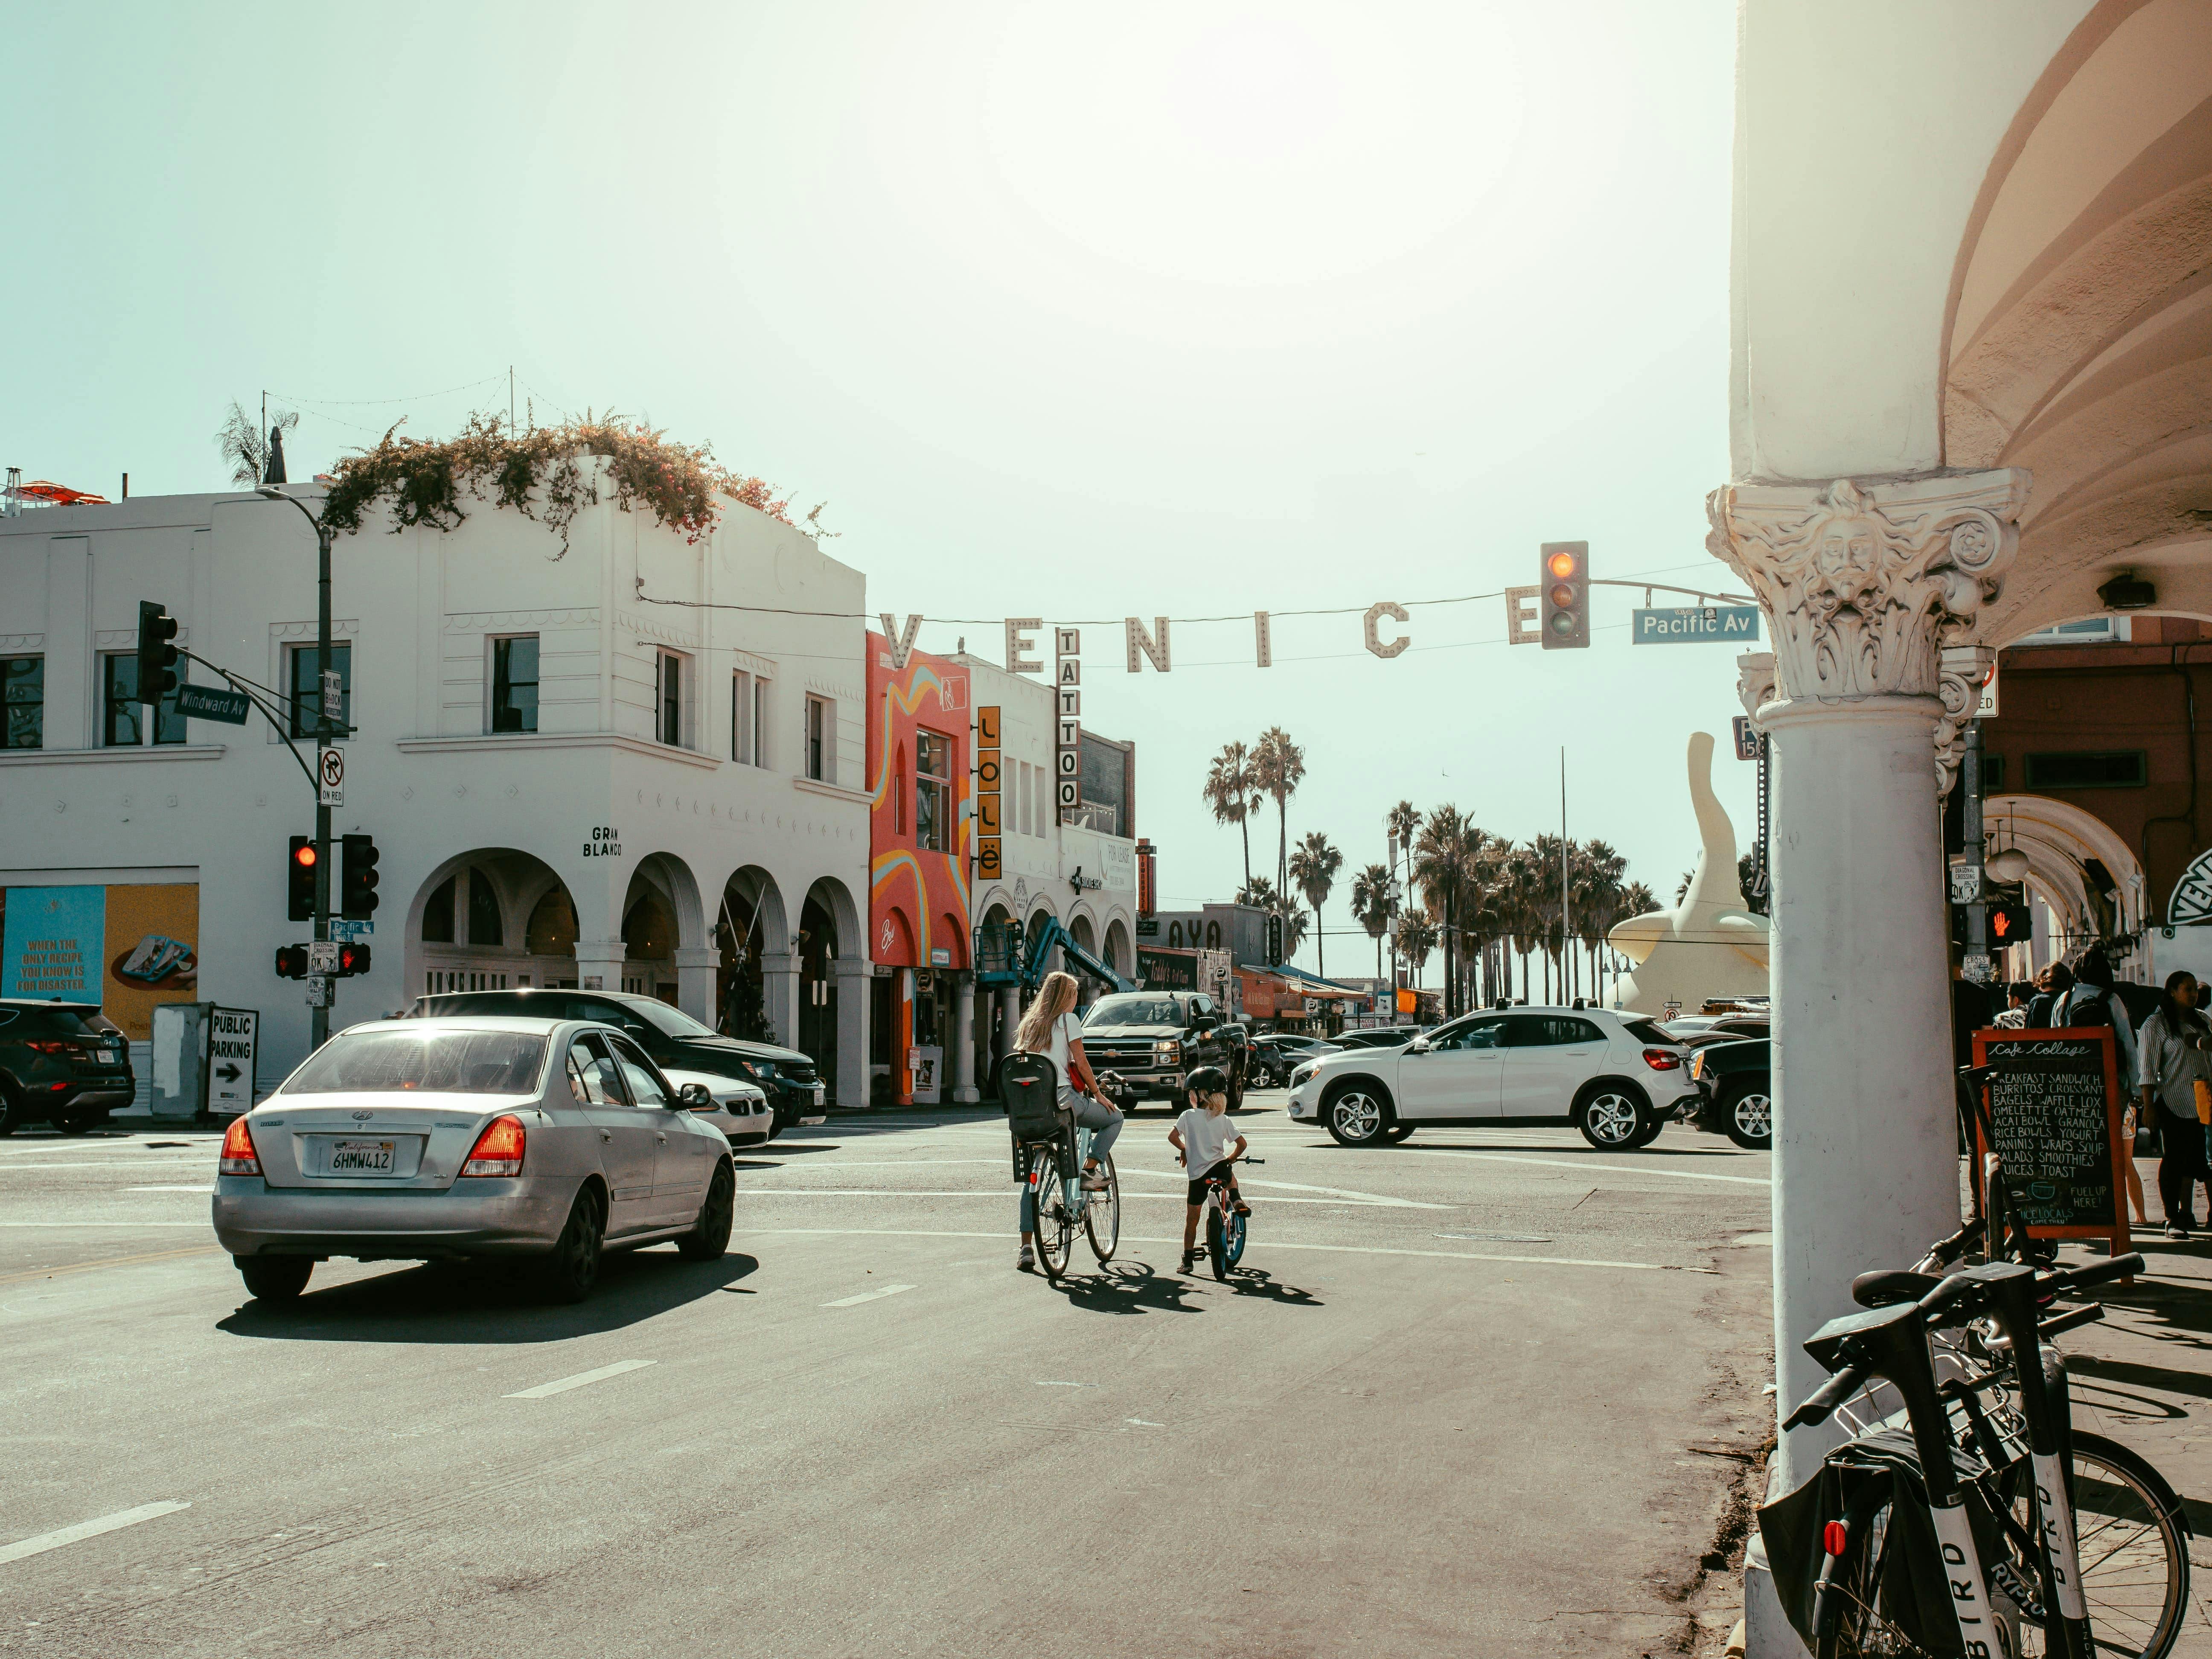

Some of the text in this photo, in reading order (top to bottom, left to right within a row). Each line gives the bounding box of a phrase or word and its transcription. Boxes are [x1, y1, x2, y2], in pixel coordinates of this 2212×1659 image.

[879, 585, 1542, 673] VENICE
[1644, 614, 1749, 634] Pacific Av
[326, 677, 331, 688] DO
[181, 692, 244, 716] Windward Av
[1979, 697, 1993, 709] ED
[1061, 632, 1075, 803] TATTOO
[1742, 742, 1755, 757] 15
[323, 791, 342, 801] ON RED
[592, 827, 618, 841] GRAN
[583, 843, 621, 857] BLANCO
[1109, 844, 1117, 862] FOR
[1117, 847, 1130, 864] LEASE
[1082, 877, 1094, 888] SMOKE
[2175, 857, 2212, 917] VEN
[1169, 920, 1221, 952] AYA
[27, 939, 77, 951] WHEN THE
[22, 952, 83, 965] ONLY RECIPE
[311, 957, 322, 969] OK
[21, 966, 84, 978] YOU KNOW IS
[17, 979, 86, 991] FOR DISASTER.
[213, 1015, 251, 1035] PUBLIC
[211, 1040, 251, 1059] PARKING
[1988, 1042, 2025, 1057] Cafe
[1998, 1073, 2100, 1086] EAKFAST SANDWICH
[1994, 1084, 2105, 1095] BURRITOS CROISSANT
[1994, 1094, 2101, 1108] BAGELS WAFFLE LOX
[1994, 1106, 2104, 1119] OMELETTE OATMEAL
[1994, 1116, 2105, 1130] ACAI BOWL GRANOLA
[1995, 1127, 2100, 1141] RICE BOWLS YOGURT
[344, 1142, 382, 1153] California
[1995, 1139, 2105, 1156] PANINIS WRAPS SOUP
[334, 1153, 389, 1168] 6HMW412
[2001, 1151, 2095, 1167] ALADS SMOOTHIES
[2040, 1165, 2076, 1178] TOAST
[2071, 1186, 2107, 1196] FUEL UP
[2074, 1198, 2101, 1208] HERE!
[2038, 1208, 2074, 1219] LOCALS
[1942, 1543, 1991, 1659] BIRD
